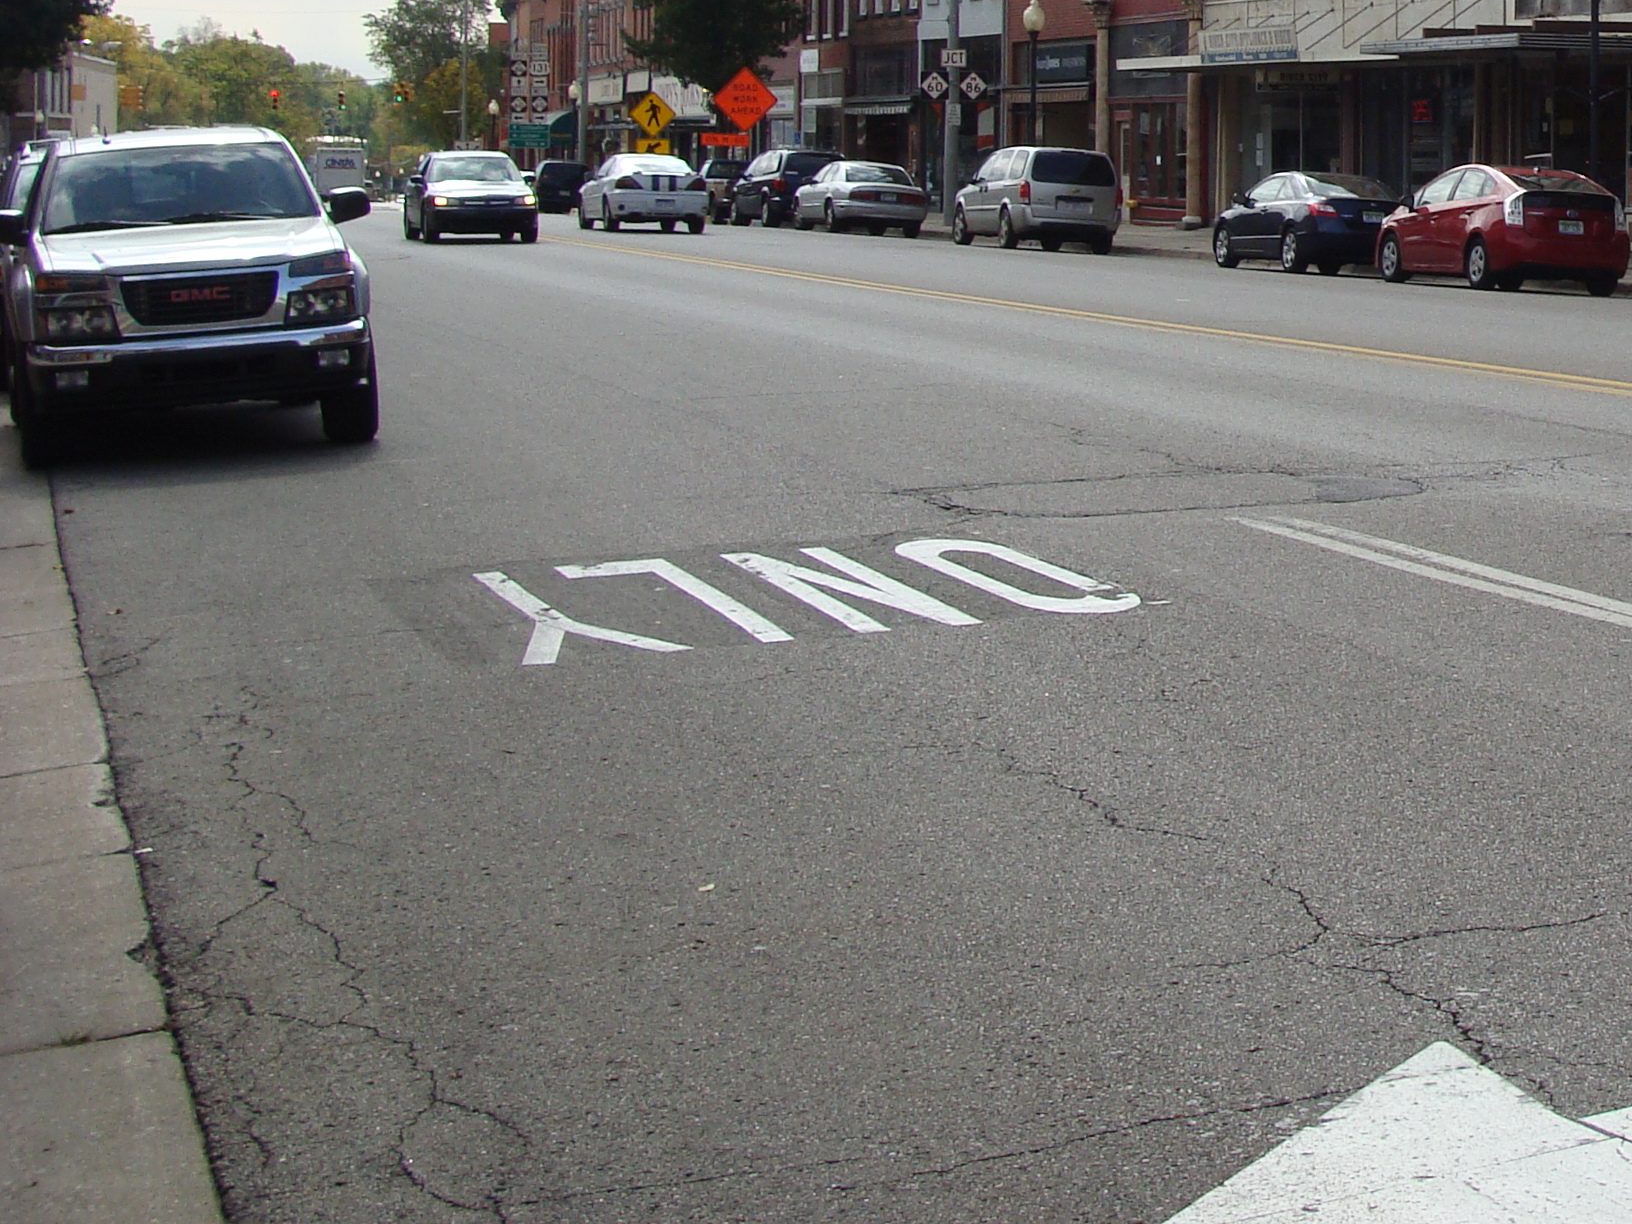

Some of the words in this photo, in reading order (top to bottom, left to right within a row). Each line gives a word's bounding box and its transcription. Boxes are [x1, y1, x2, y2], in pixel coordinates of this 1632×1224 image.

[944, 52, 964, 64] JCT
[533, 63, 548, 73] 131
[732, 83, 758, 92] ROAD
[927, 81, 943, 92] 60
[965, 82, 981, 93] 86
[732, 95, 758, 103] WORK
[731, 106, 762, 115] AHEAD
[170, 286, 231, 303] GMC
[472, 537, 1142, 666] ONLY
